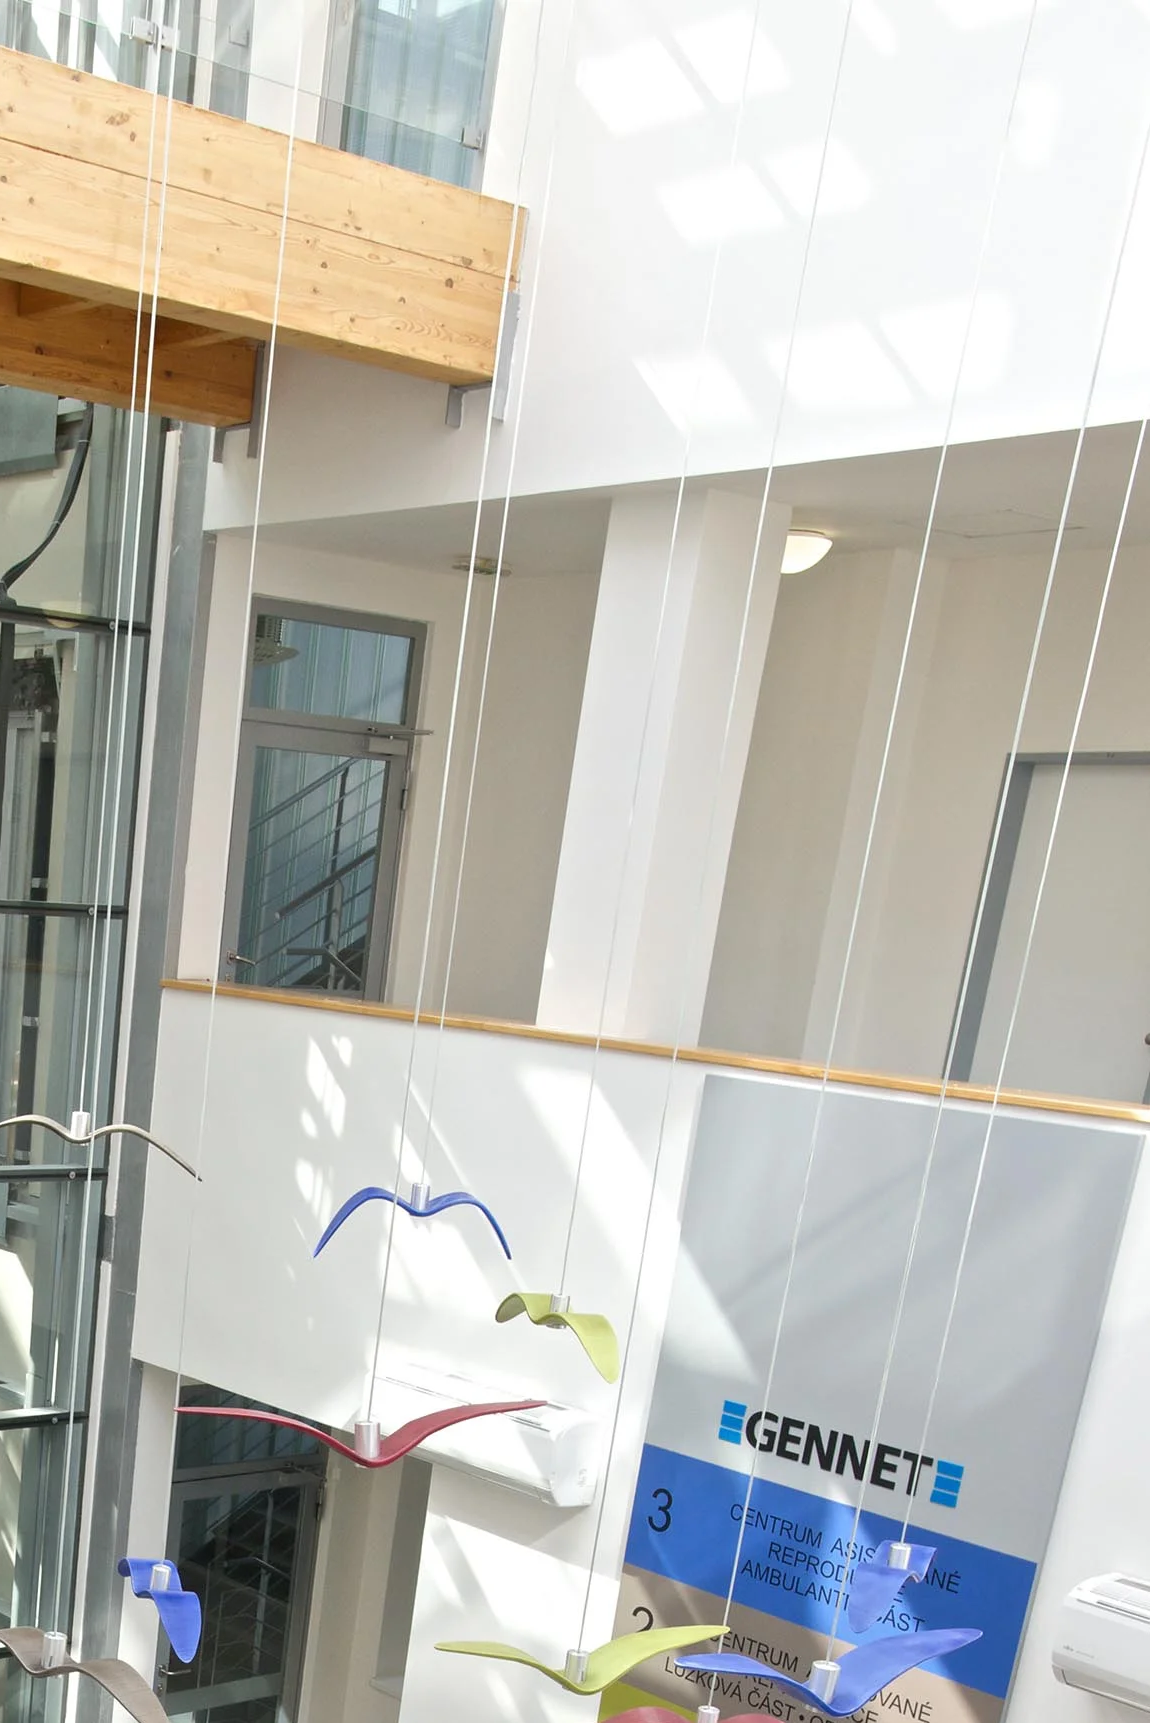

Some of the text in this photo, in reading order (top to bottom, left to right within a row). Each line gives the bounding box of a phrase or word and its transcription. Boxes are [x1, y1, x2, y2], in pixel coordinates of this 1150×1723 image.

[746, 1410, 934, 1497] GENNET
[648, 1488, 673, 1532] 3
[730, 1504, 823, 1548] CENTRUM
[876, 1604, 925, 1632] ÁST
[747, 1689, 796, 1721] ČÁST
